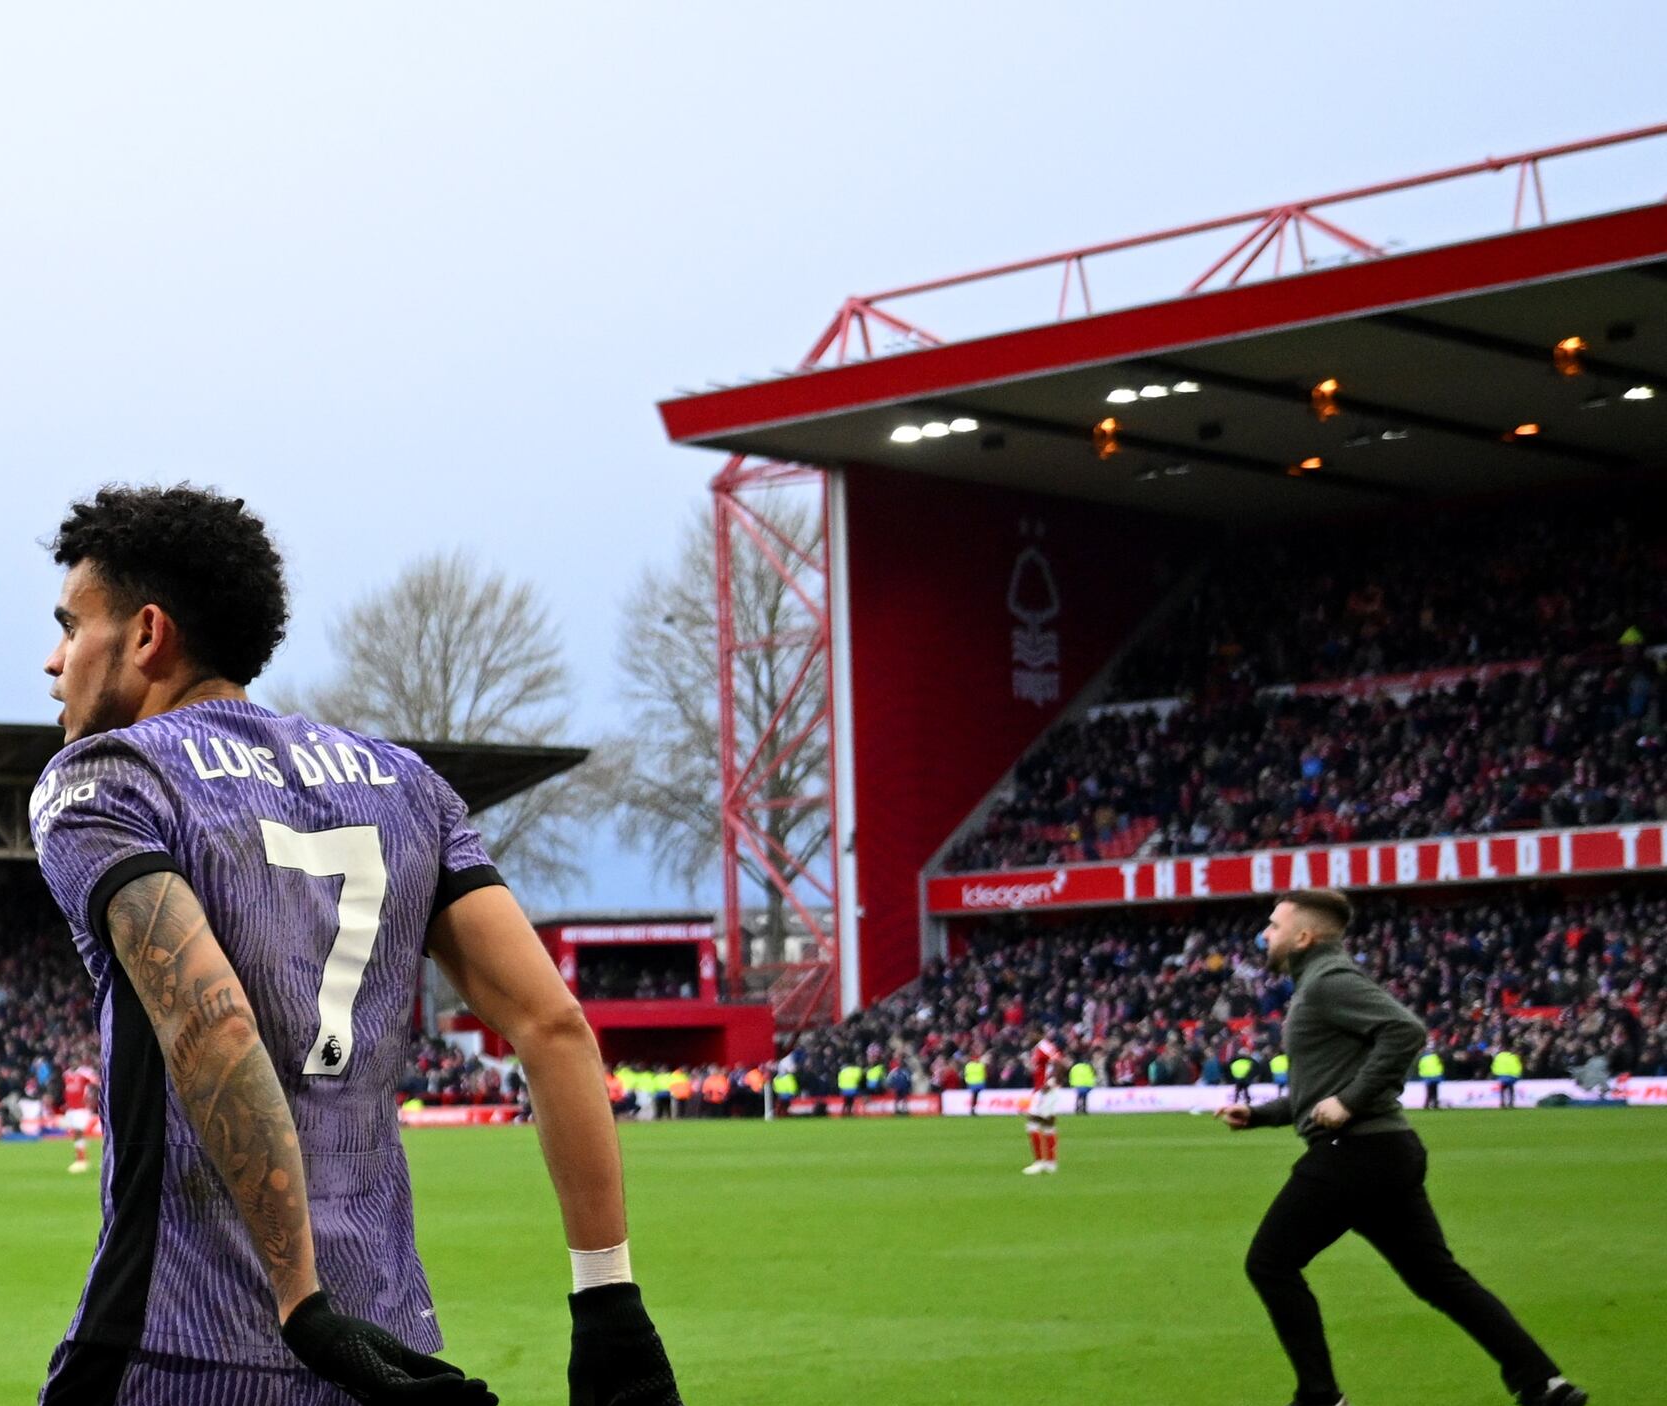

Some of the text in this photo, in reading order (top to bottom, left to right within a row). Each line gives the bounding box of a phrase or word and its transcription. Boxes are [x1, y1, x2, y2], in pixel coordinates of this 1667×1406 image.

[182, 737, 284, 788] LUIS
[962, 882, 1052, 909] Ideagen
[1121, 857, 1210, 901] THE
[1251, 831, 1573, 893] GARIBALDI
[259, 819, 387, 1076] 7
